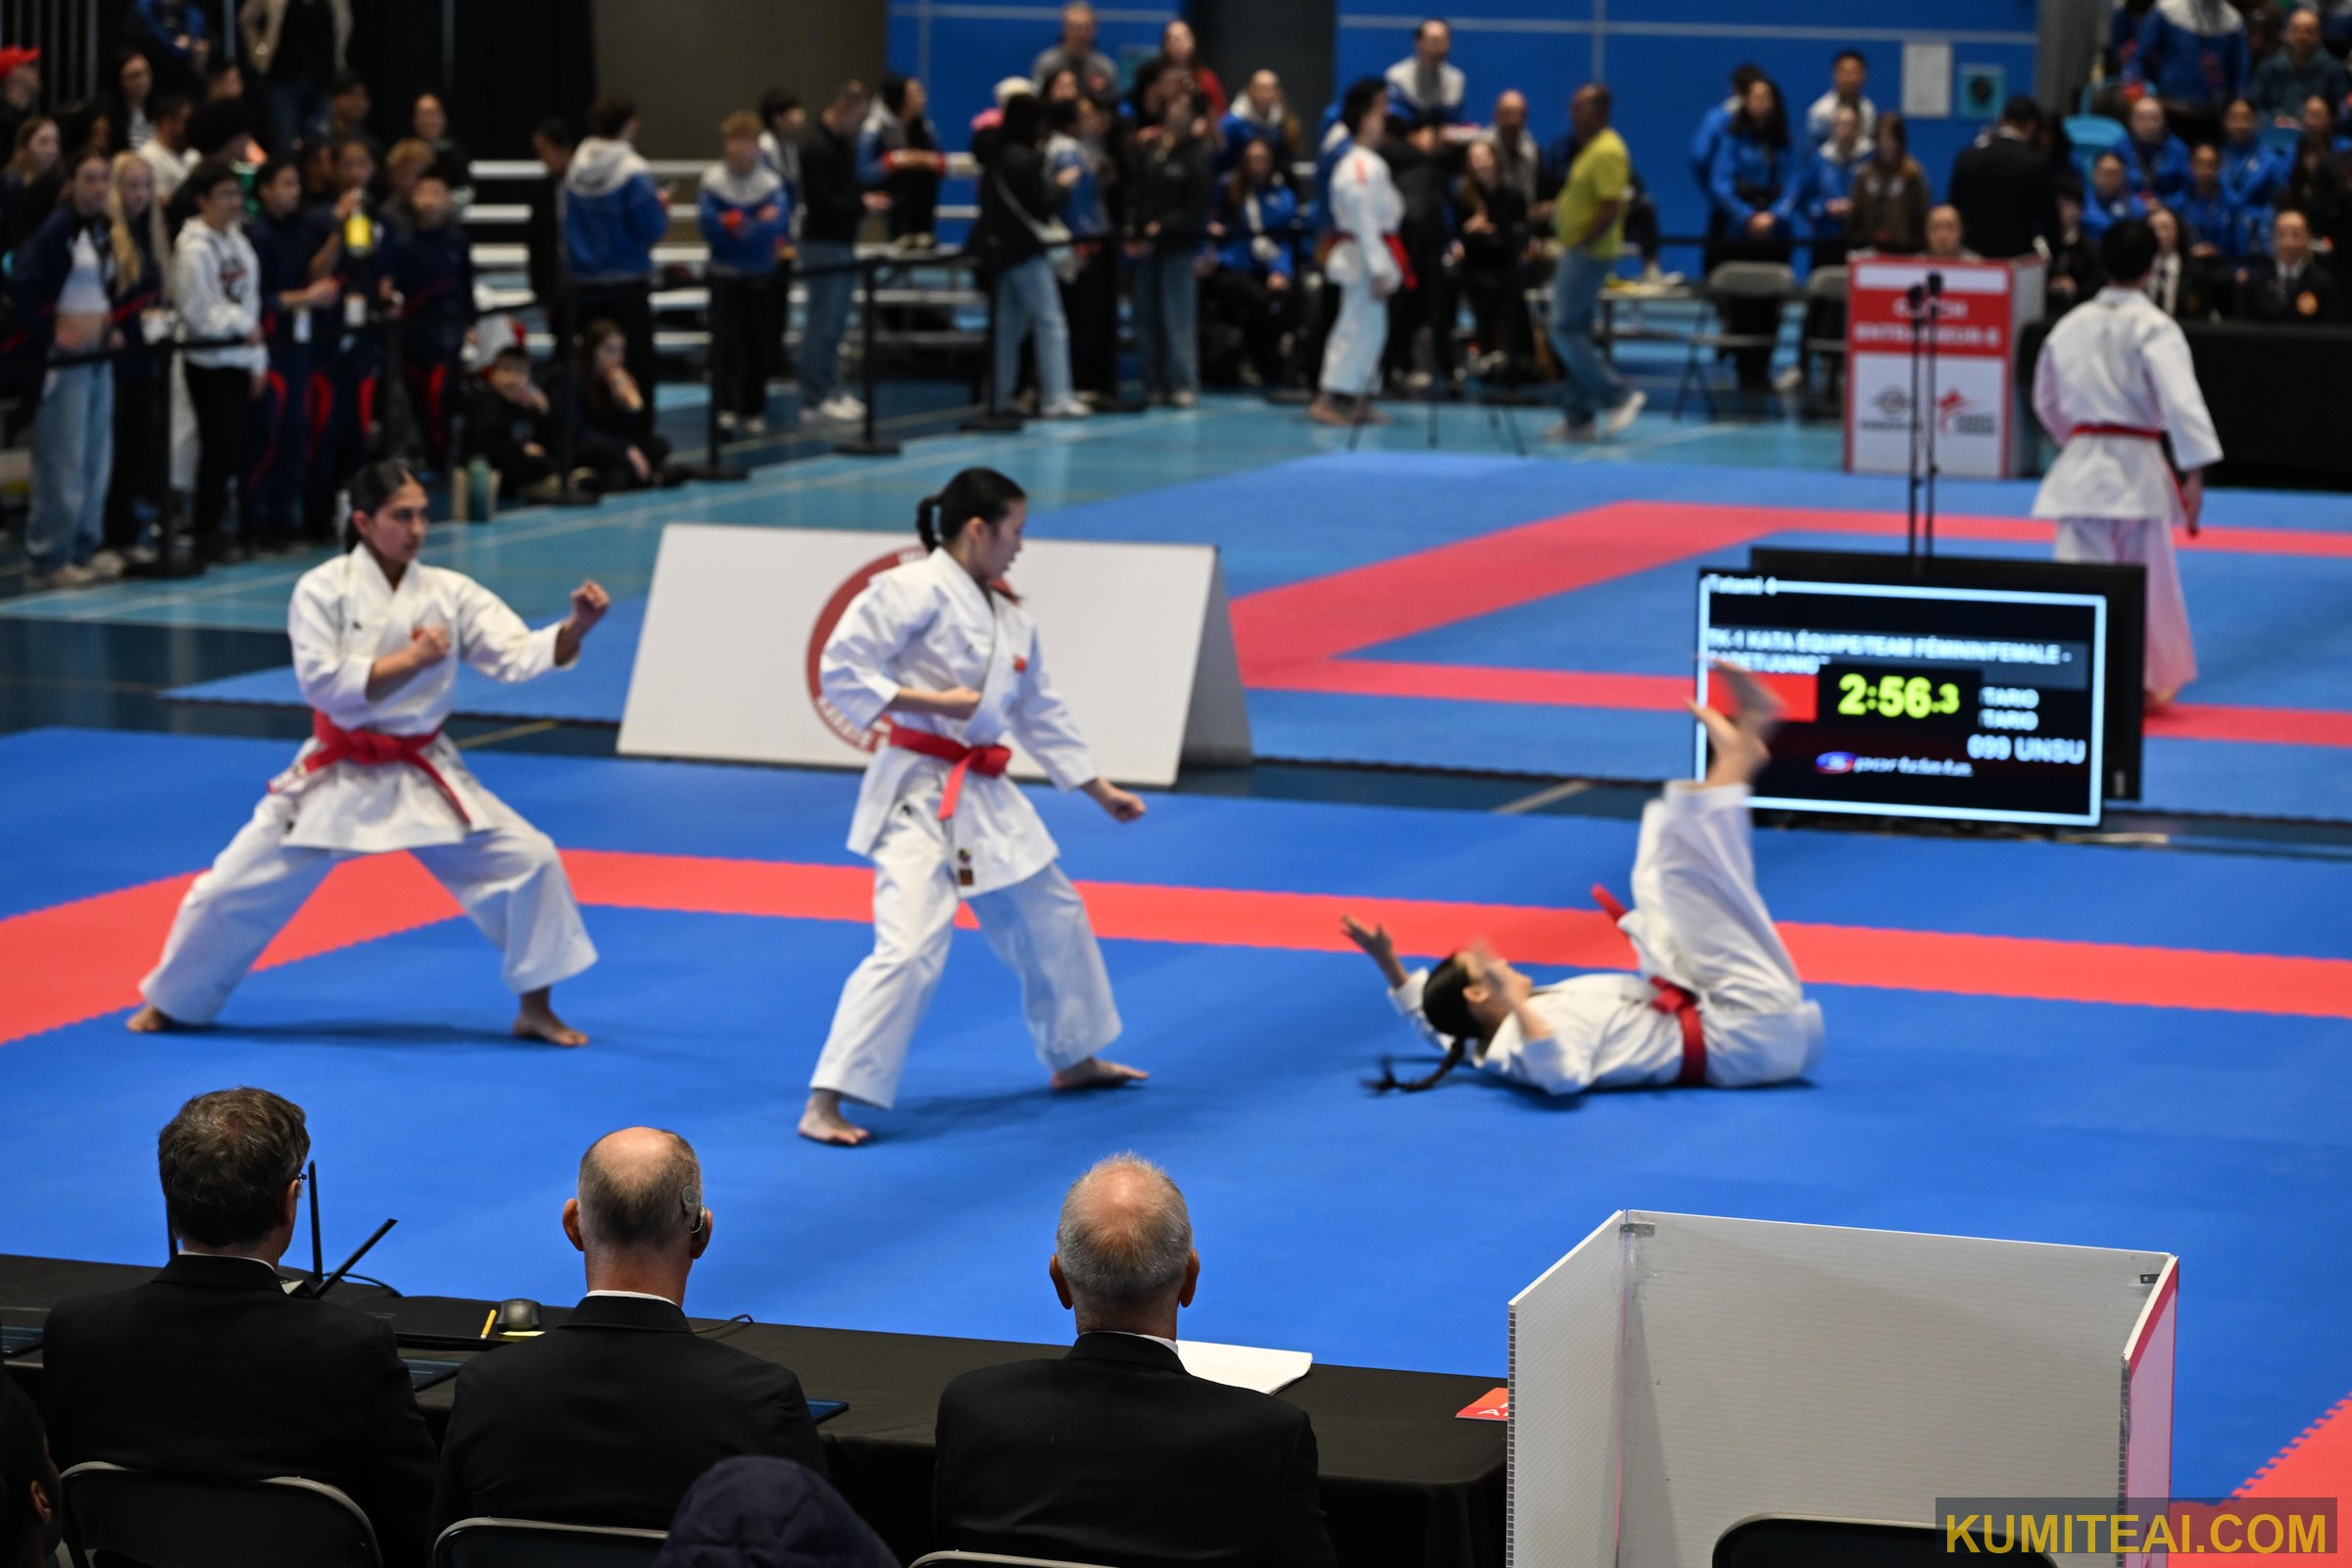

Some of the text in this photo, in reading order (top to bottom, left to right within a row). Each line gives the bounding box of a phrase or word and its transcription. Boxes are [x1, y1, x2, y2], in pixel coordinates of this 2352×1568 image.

[1746, 630, 1794, 651] KATA
[1837, 673, 1960, 718] 2:56.3
[2014, 735, 2086, 764] UNSU
